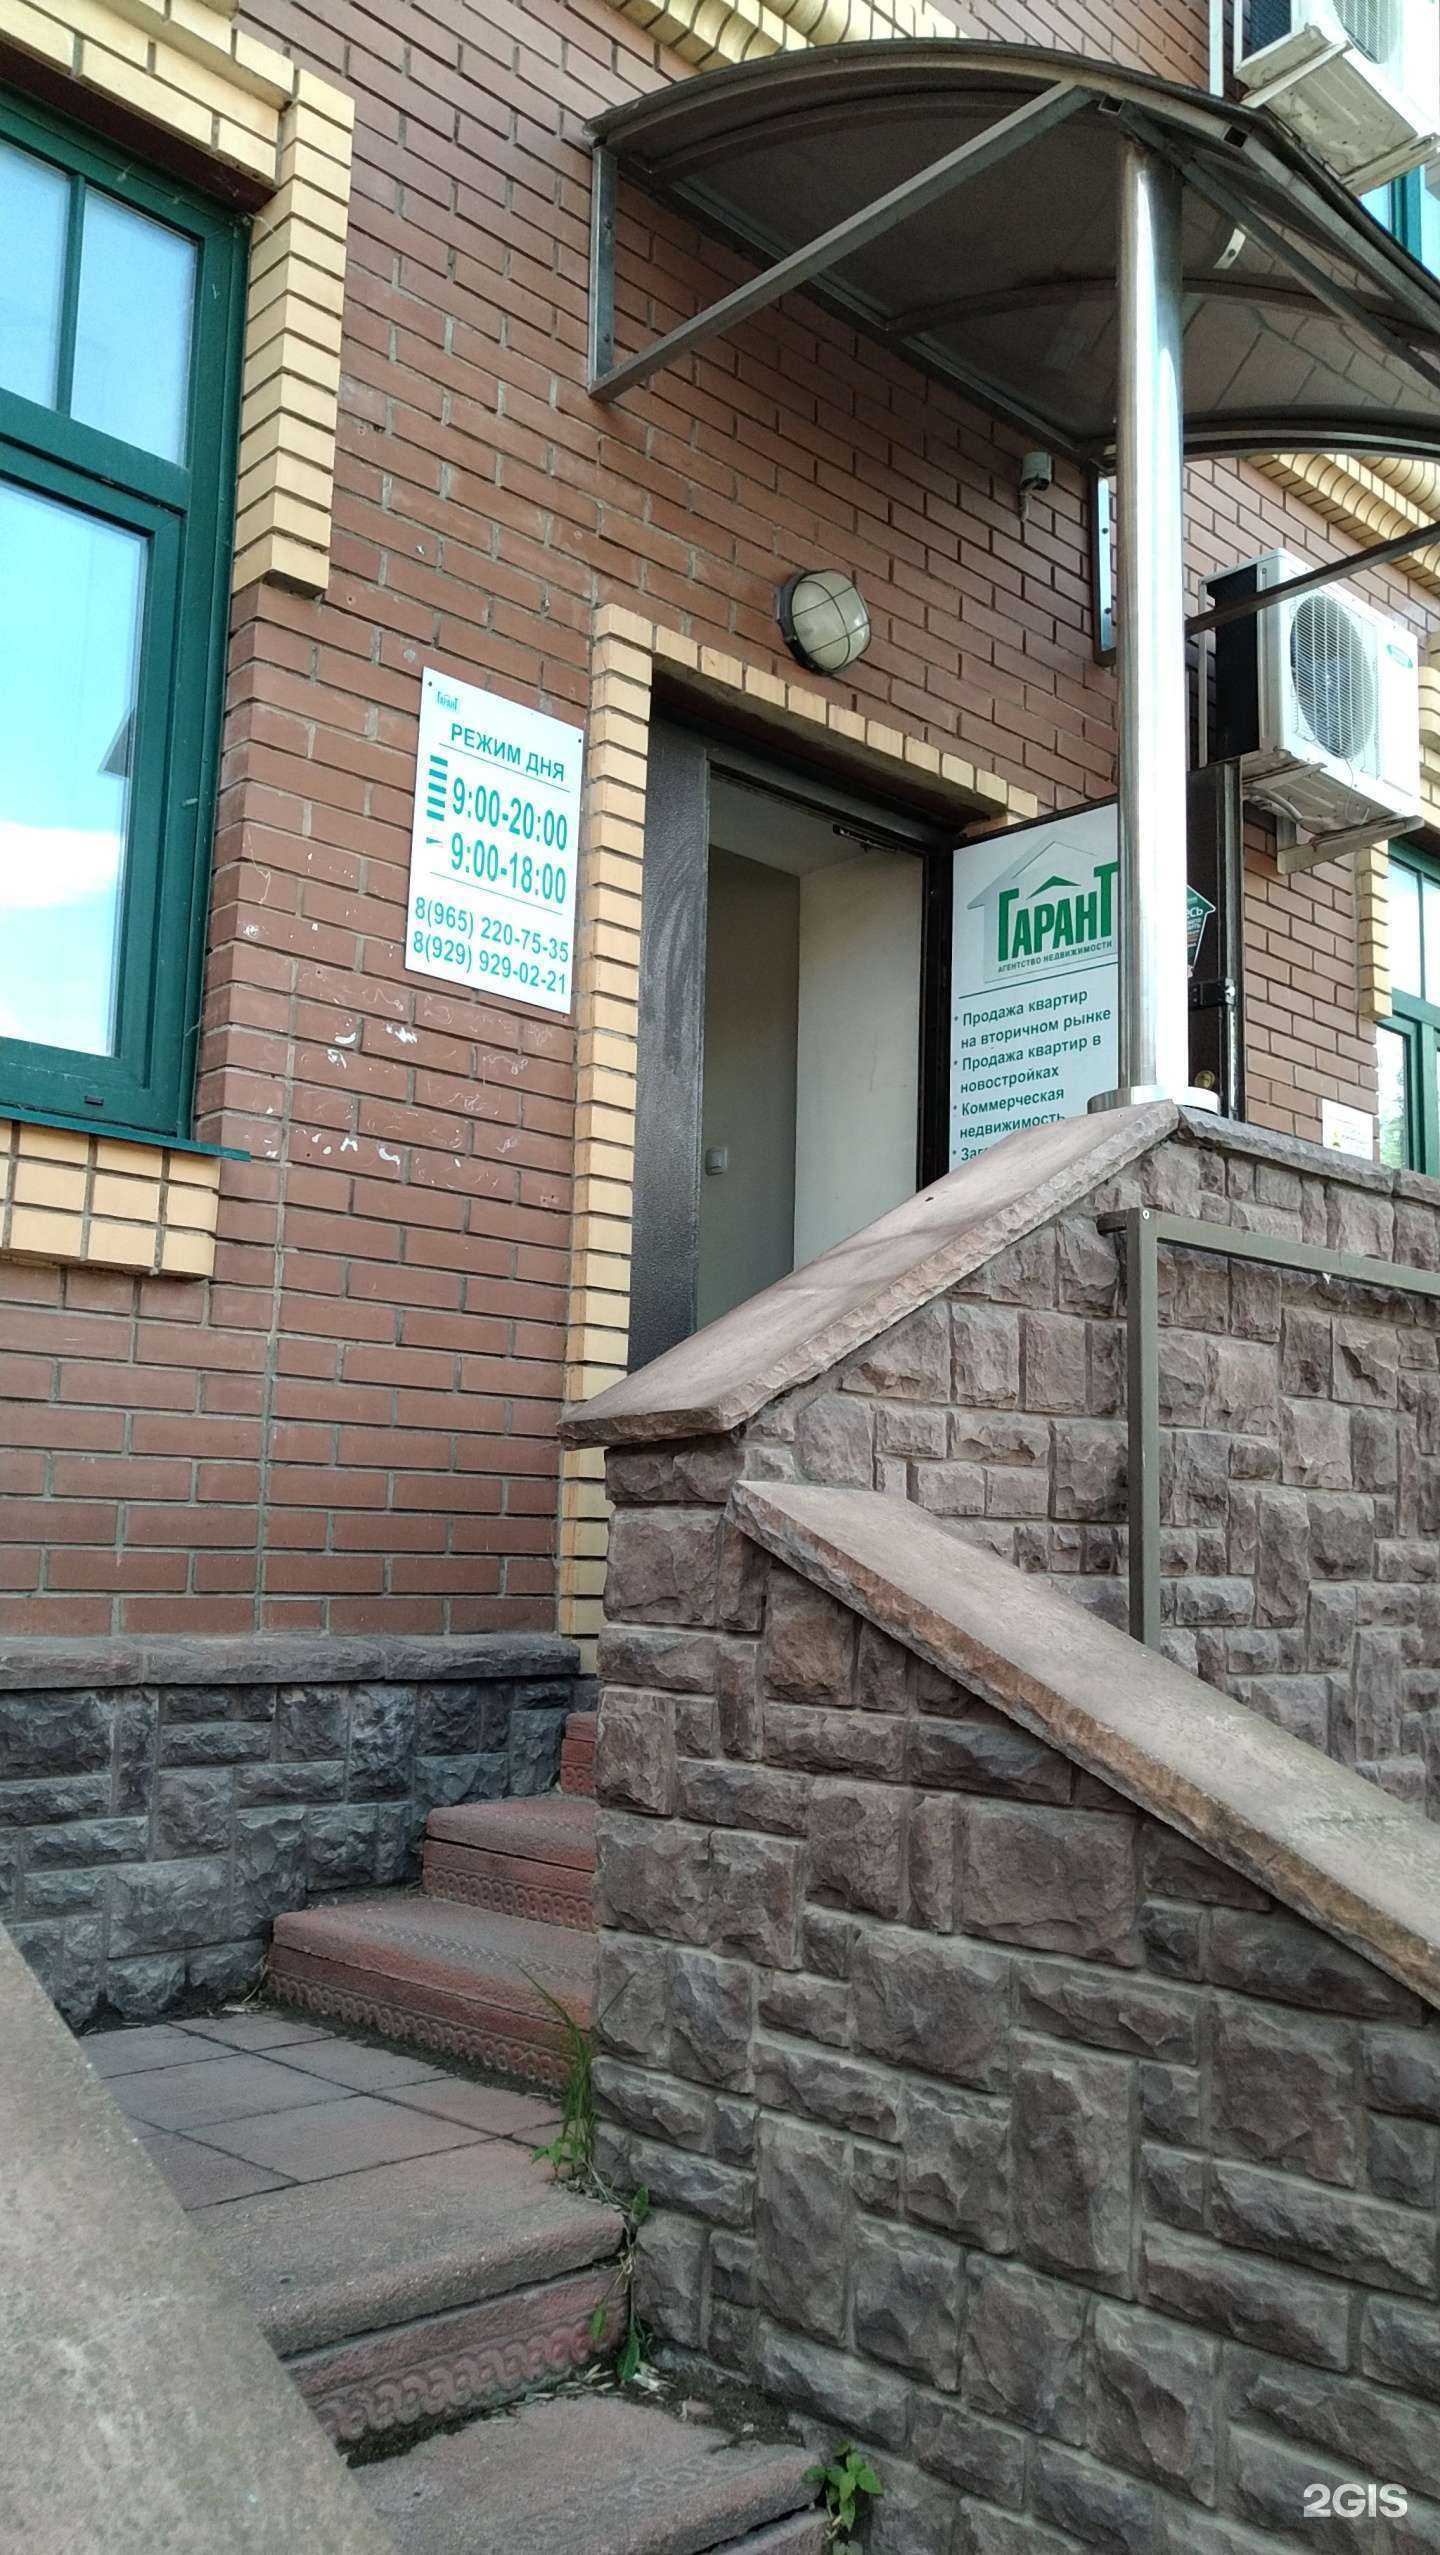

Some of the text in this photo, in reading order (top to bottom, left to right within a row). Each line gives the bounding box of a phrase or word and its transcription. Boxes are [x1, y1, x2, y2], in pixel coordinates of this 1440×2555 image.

[450, 723, 565, 782] РЕЖИМ ДНЯ
[452, 777, 568, 850] 9:00-20:00
[451, 832, 566, 904] 9:00-18:00
[415, 896, 569, 963] 8(965) 220-75-35
[997, 861, 1120, 962] ГАРАНТ
[413, 931, 566, 994] 8(929) 929-02-21
[998, 940, 1113, 973] АГЕНТСТВО НЕДВИЖИМОСТИ
[961, 1009, 1111, 1049] на вторичном рынке
[963, 990, 1088, 1027] Продажа квартир
[962, 1034, 1102, 1072] Продажа квартир в
[960, 1065, 1060, 1093] новостройках
[962, 1088, 1065, 1116] Коммерческая
